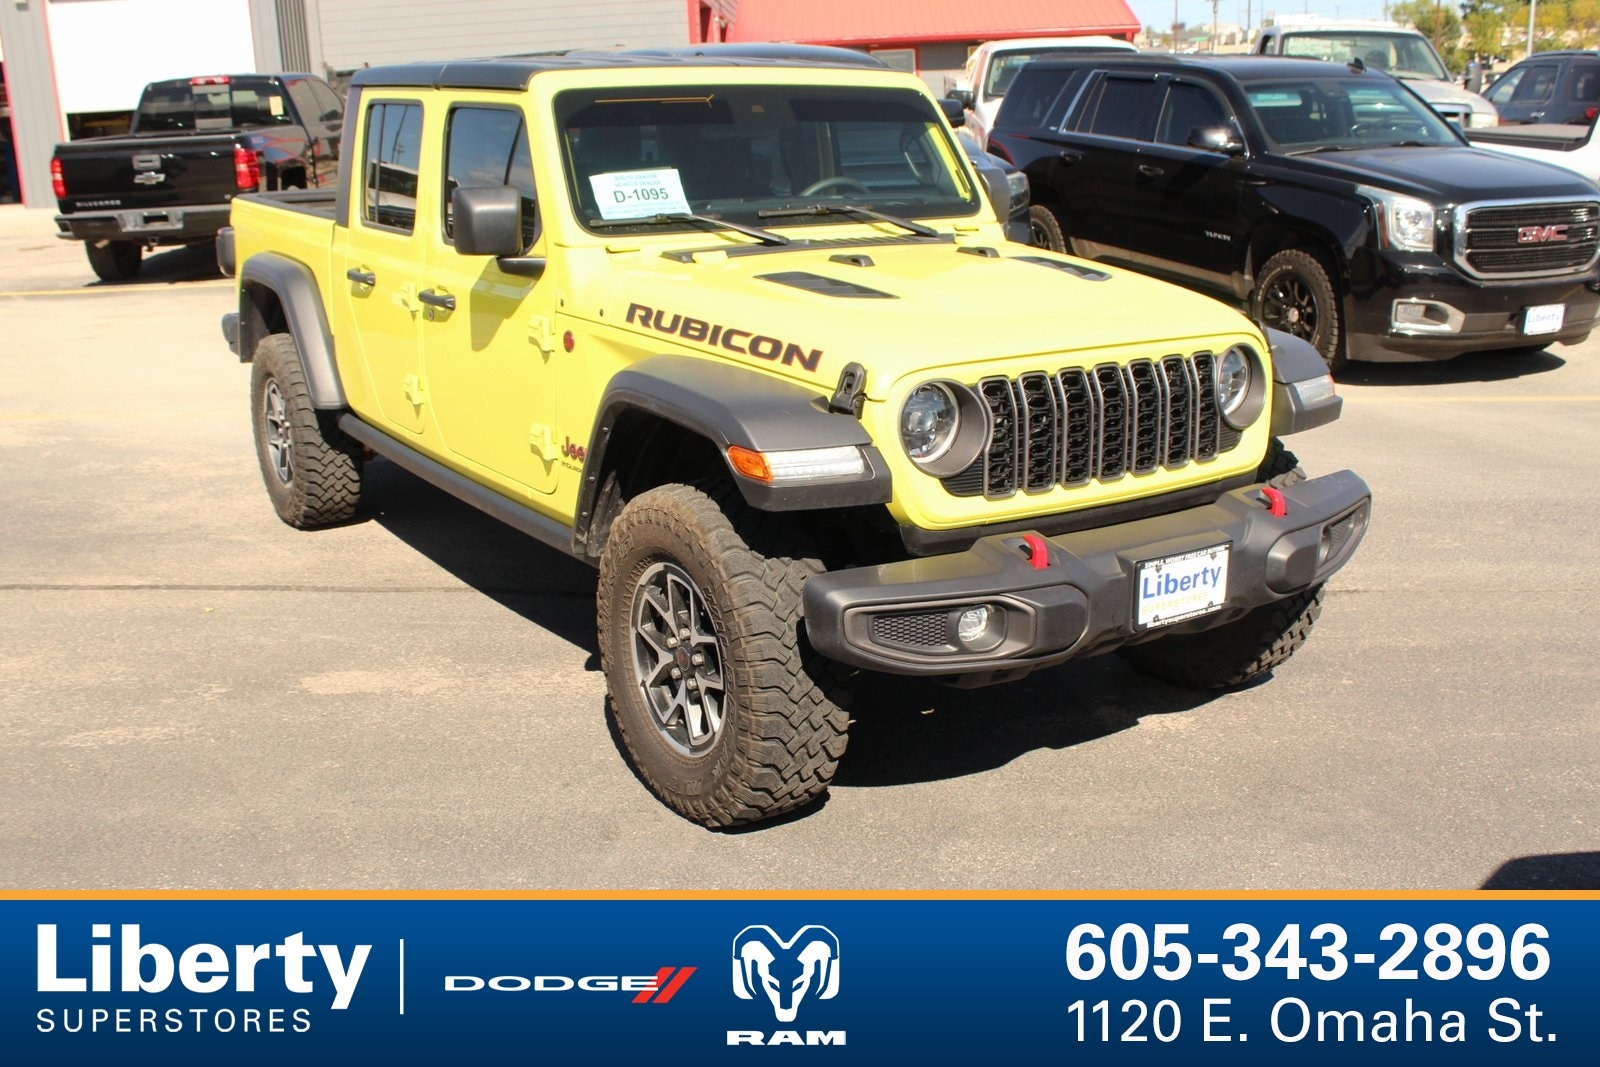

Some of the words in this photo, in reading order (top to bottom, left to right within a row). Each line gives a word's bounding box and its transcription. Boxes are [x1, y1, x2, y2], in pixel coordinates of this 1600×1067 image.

[614, 188, 669, 203] D-1095
[1518, 225, 1569, 244] GMC
[625, 303, 824, 373] RUBICON
[561, 436, 588, 463] Jee
[1142, 565, 1222, 600] Liberty
